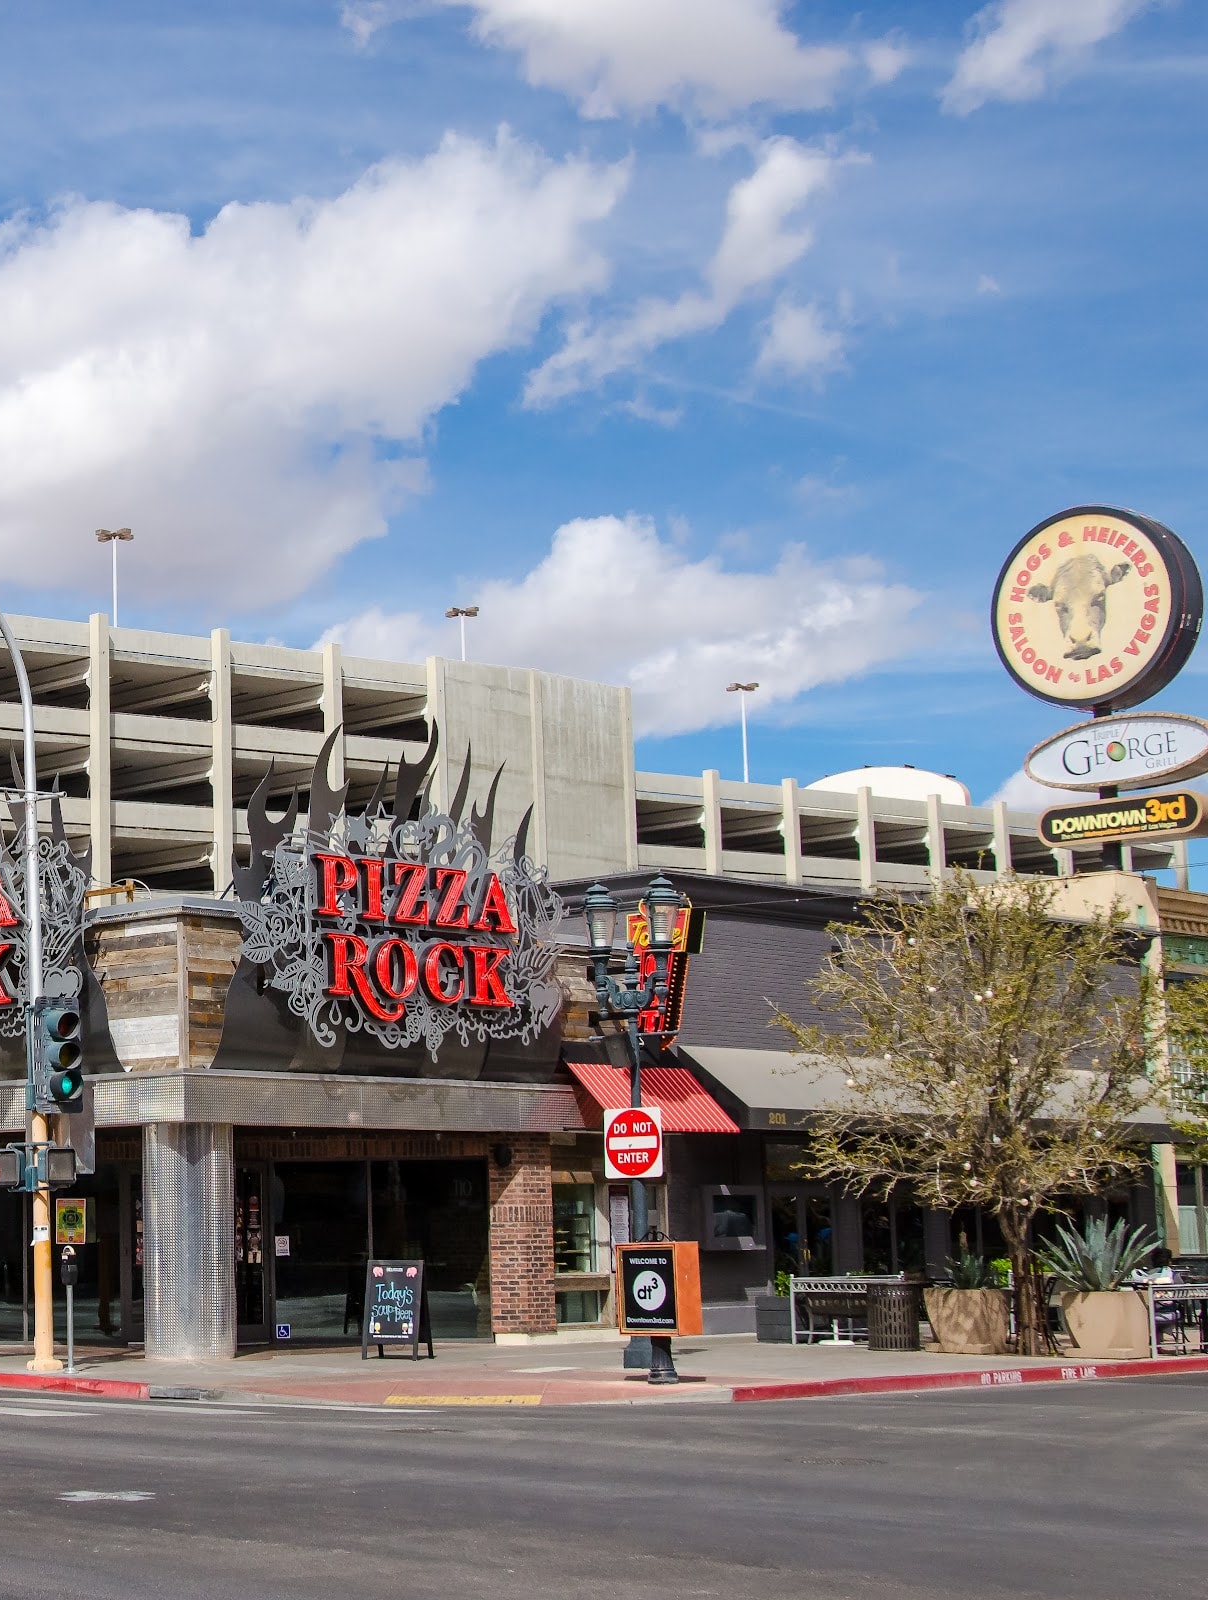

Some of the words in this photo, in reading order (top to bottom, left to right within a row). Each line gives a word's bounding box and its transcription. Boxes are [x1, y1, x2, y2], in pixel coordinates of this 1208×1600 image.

[1010, 543, 1052, 602] HOGS
[1058, 531, 1075, 548] &
[1082, 526, 1154, 577] HEIFERS
[1008, 612, 1063, 684] SALOON
[1085, 656, 1123, 685] LAS
[1123, 583, 1161, 656] VEGAS
[1063, 730, 1178, 775] GEORGE
[1145, 756, 1178, 769] GRILL
[1051, 808, 1147, 835] DOWNTOWN
[1146, 796, 1187, 823] 3rd
[316, 853, 519, 934] PIZZA
[327, 932, 515, 1023] ROCK
[613, 1122, 628, 1134] DO
[632, 1121, 652, 1133] NOT
[768, 1112, 787, 1125] 201
[617, 1151, 649, 1164] ENTER
[375, 1281, 414, 1308] Today's
[626, 1316, 675, 1325] Downtown3rd.com
[980, 1373, 991, 1385] NO
[993, 1371, 1023, 1384] PARKING
[1061, 1367, 1078, 1380] FIRE
[1079, 1366, 1097, 1379] LANE
